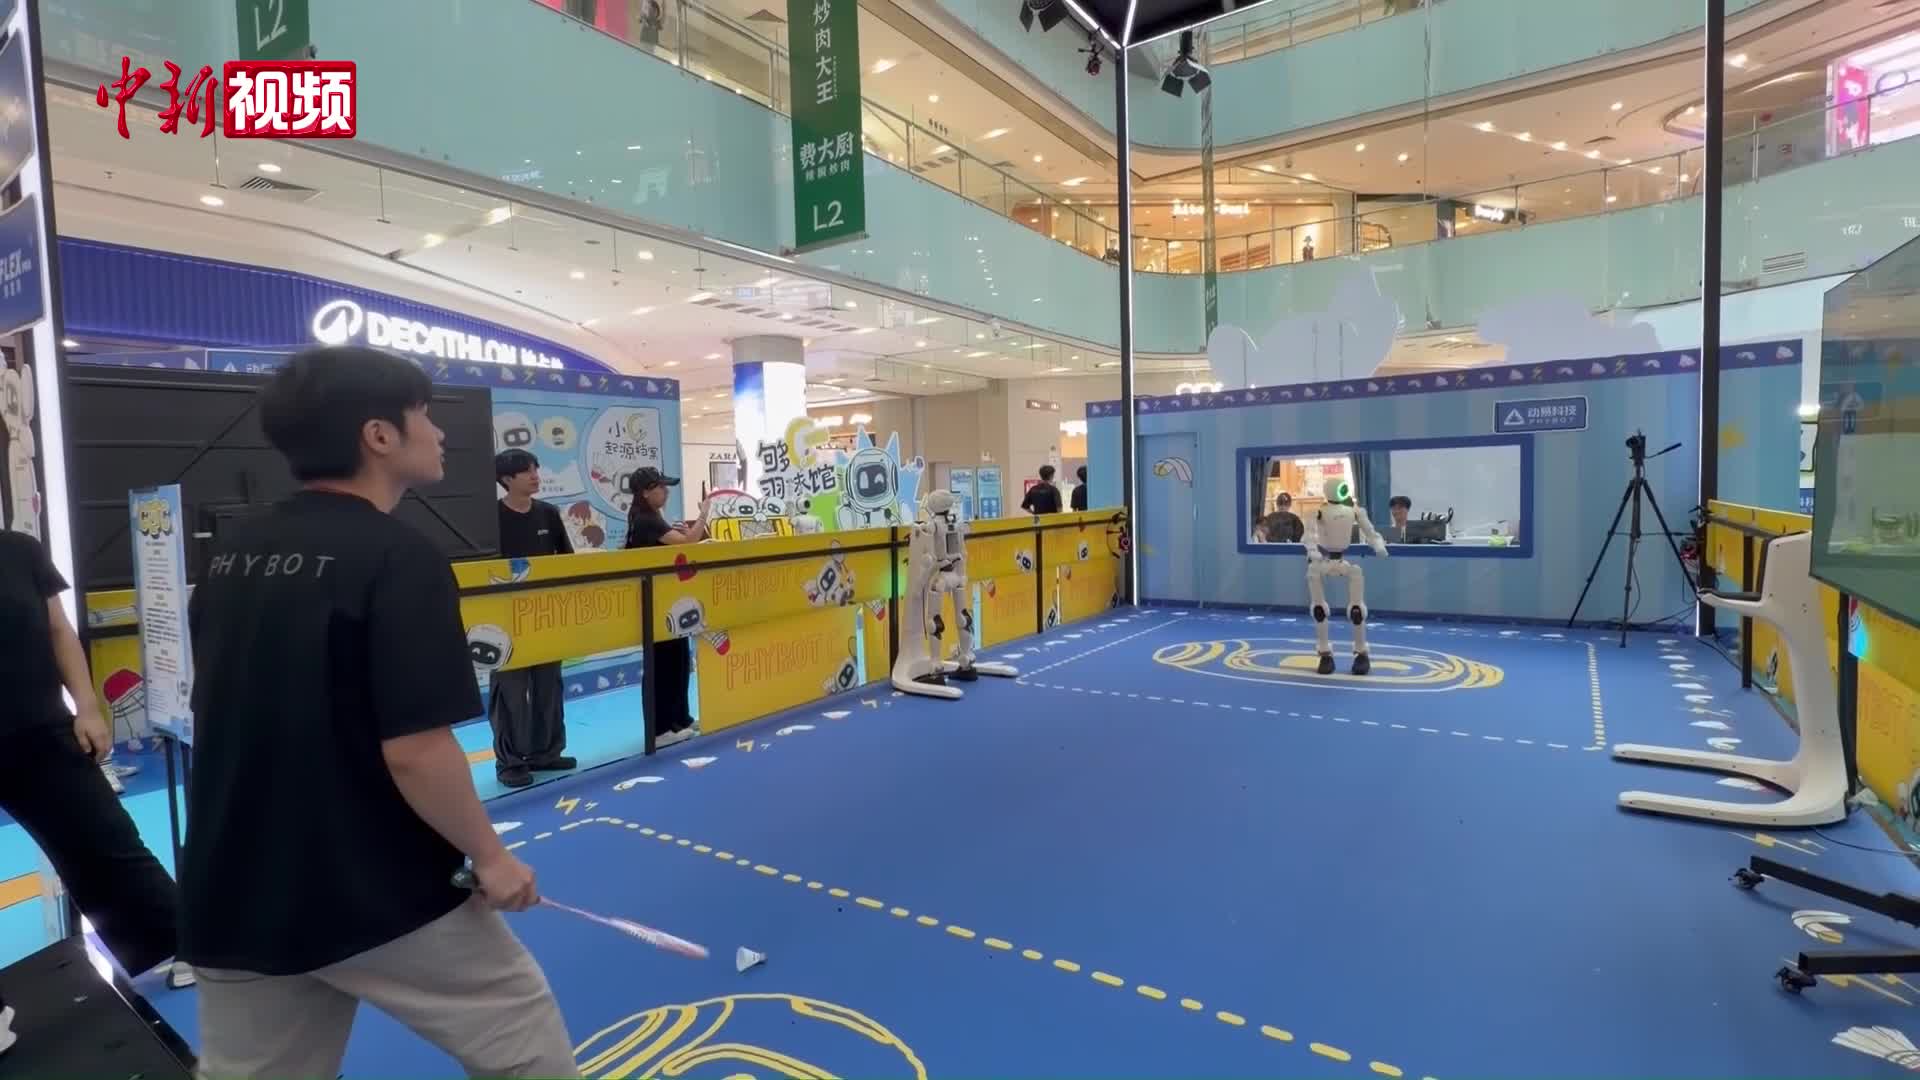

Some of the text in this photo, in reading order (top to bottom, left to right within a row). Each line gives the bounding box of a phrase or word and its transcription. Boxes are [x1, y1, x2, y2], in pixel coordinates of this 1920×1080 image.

[800, 131, 855, 170] 费大厨
[813, 200, 844, 231] L2
[367, 311, 516, 364] DECATHLON
[1529, 416, 1576, 424] PHYBOT
[208, 552, 335, 577] PHYBOT
[512, 584, 632, 637] PHYBOT
